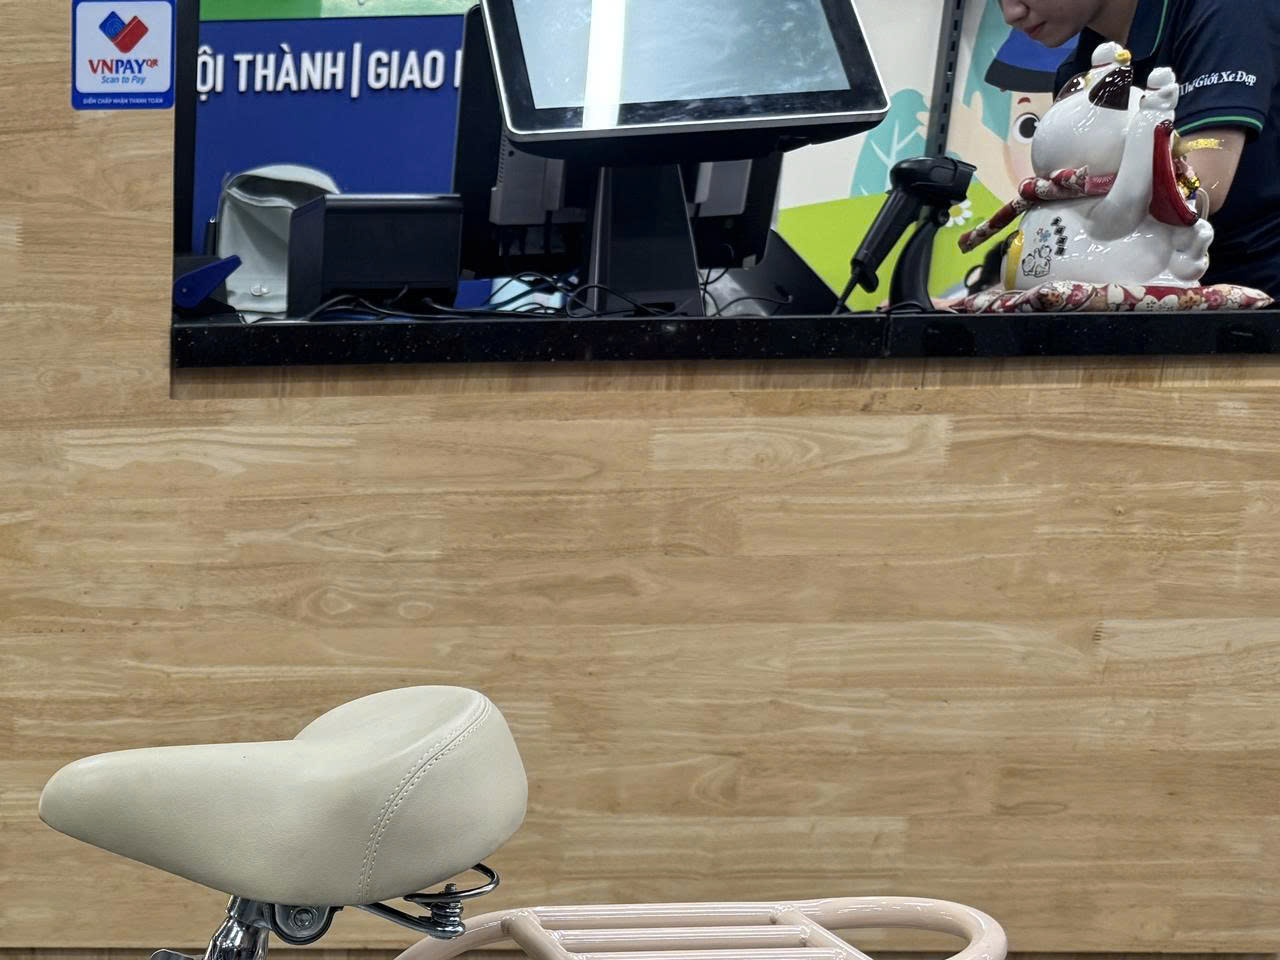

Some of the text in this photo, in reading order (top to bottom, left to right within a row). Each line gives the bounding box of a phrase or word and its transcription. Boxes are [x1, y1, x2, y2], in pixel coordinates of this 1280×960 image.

[233, 43, 345, 92] THÀNH
[367, 50, 445, 89] GIAO
[101, 75, 146, 85] Scan to Pay
[1195, 73, 1219, 87] Giới
[1219, 70, 1235, 83] Xe
[1235, 70, 1257, 86] Đạp
